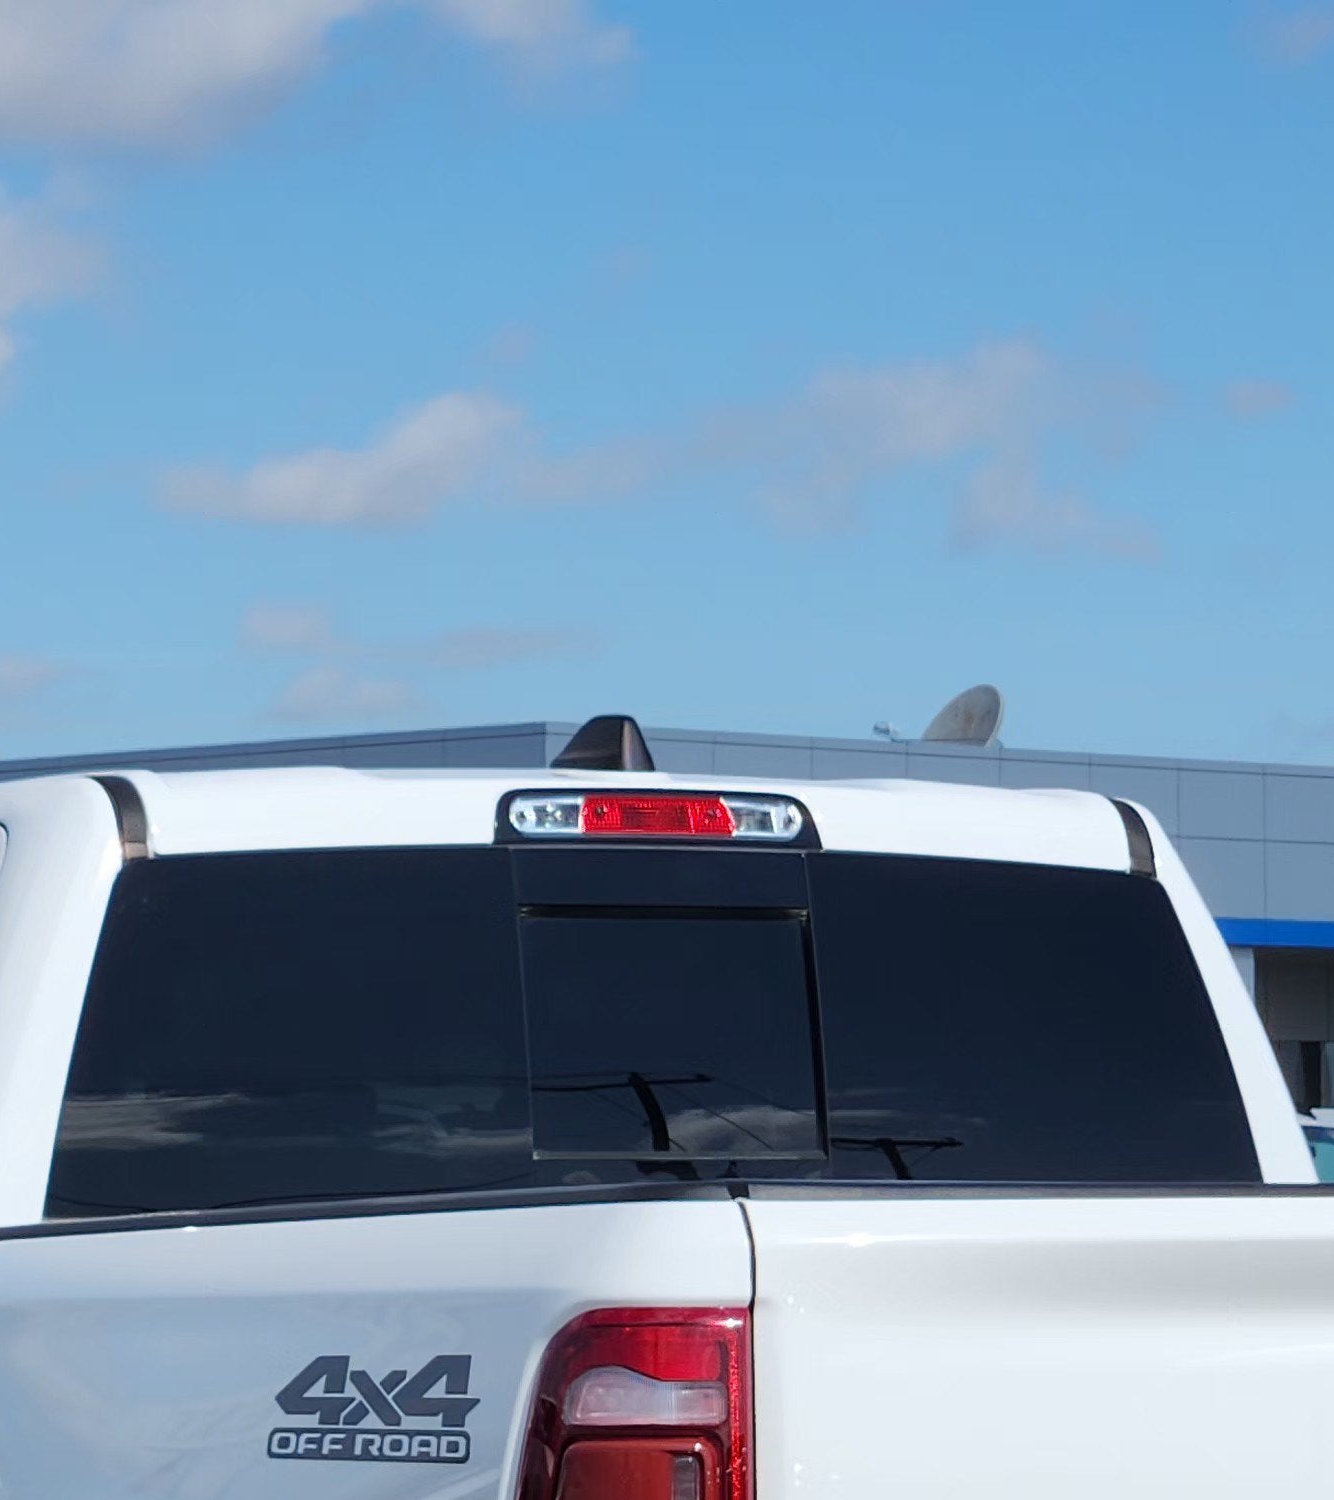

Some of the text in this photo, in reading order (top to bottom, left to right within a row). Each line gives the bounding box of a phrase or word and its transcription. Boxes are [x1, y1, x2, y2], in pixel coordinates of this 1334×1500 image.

[274, 1355, 481, 1428] 4x4
[270, 1432, 467, 1458] OFF ROAD
